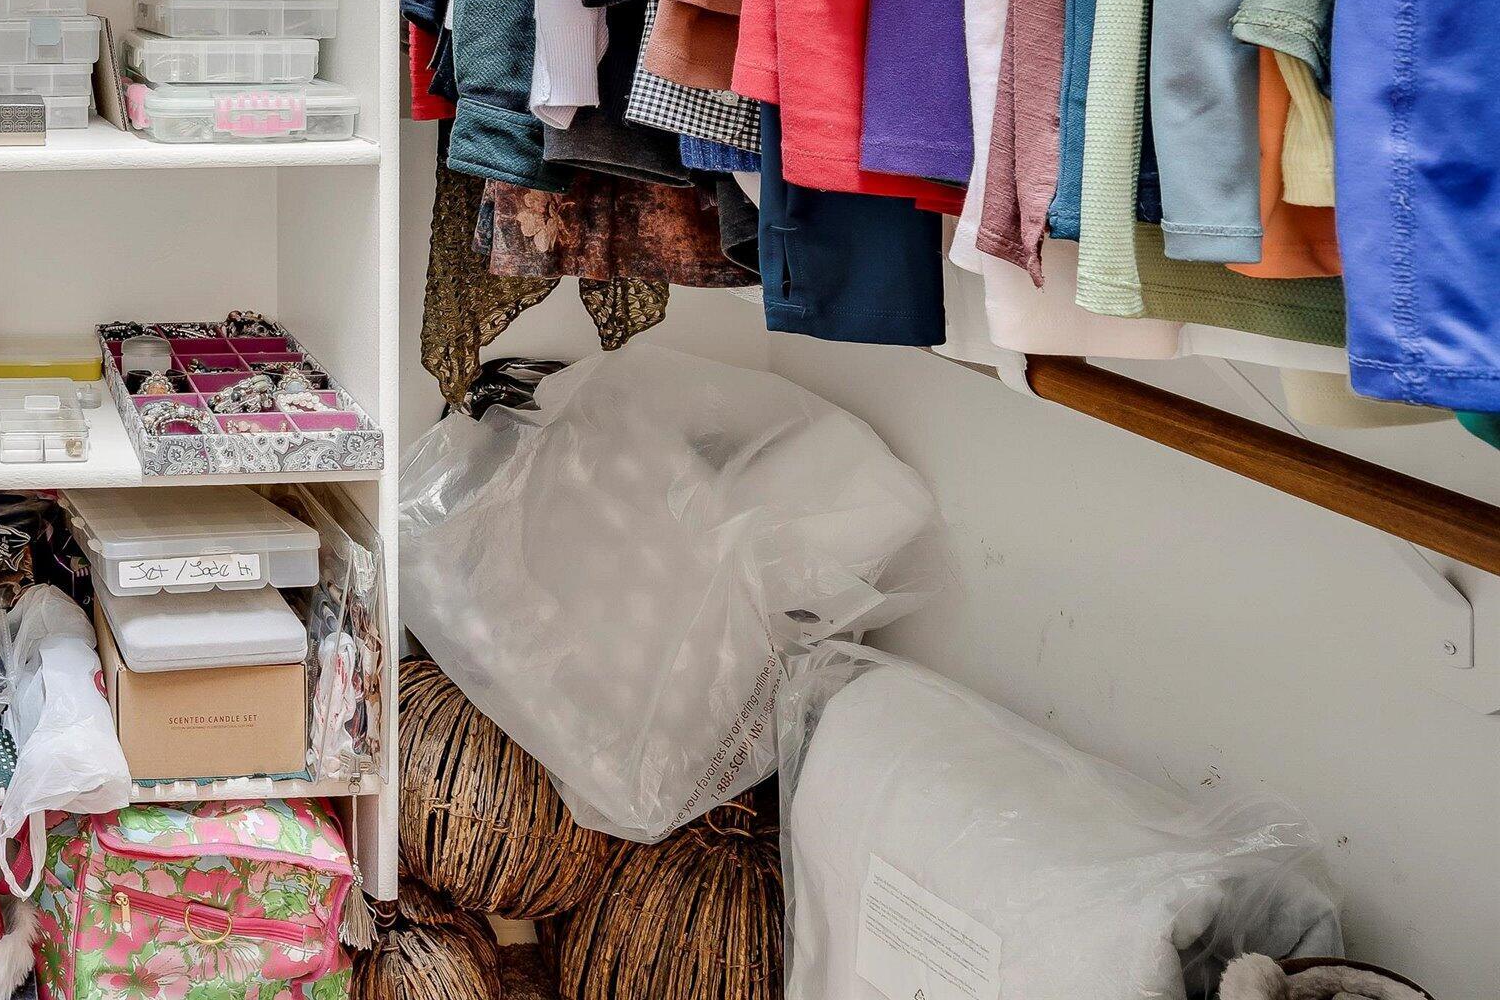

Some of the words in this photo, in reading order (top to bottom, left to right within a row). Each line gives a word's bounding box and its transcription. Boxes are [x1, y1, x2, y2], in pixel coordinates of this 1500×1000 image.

[168, 716, 205, 725] SCENTED
[208, 715, 240, 724] CANDLE
[243, 714, 258, 722] SET
[682, 788, 702, 815] your
[698, 746, 728, 791] favorites
[722, 732, 736, 748] by
[753, 667, 772, 697] online
